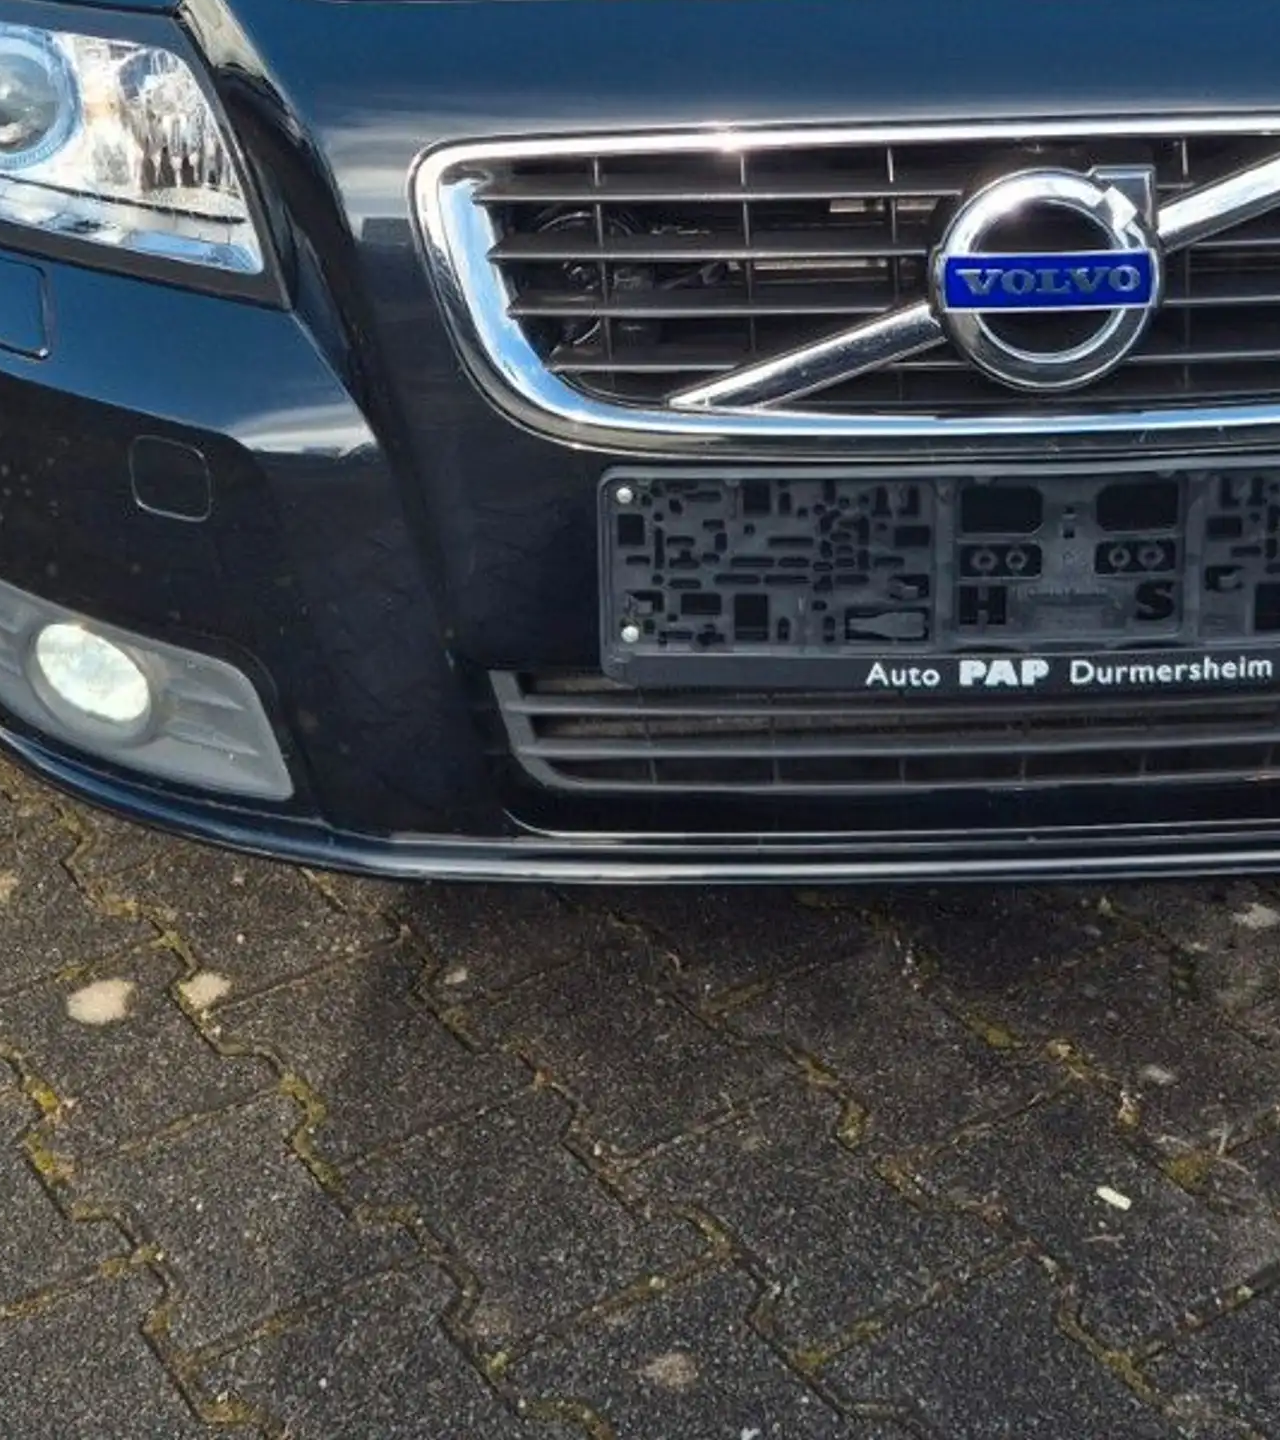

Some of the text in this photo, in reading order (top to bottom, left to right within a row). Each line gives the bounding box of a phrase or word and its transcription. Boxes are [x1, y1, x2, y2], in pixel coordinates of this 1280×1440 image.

[955, 264, 1141, 296] VOLVO
[865, 655, 1274, 687] Auto PAP Durmersheim
